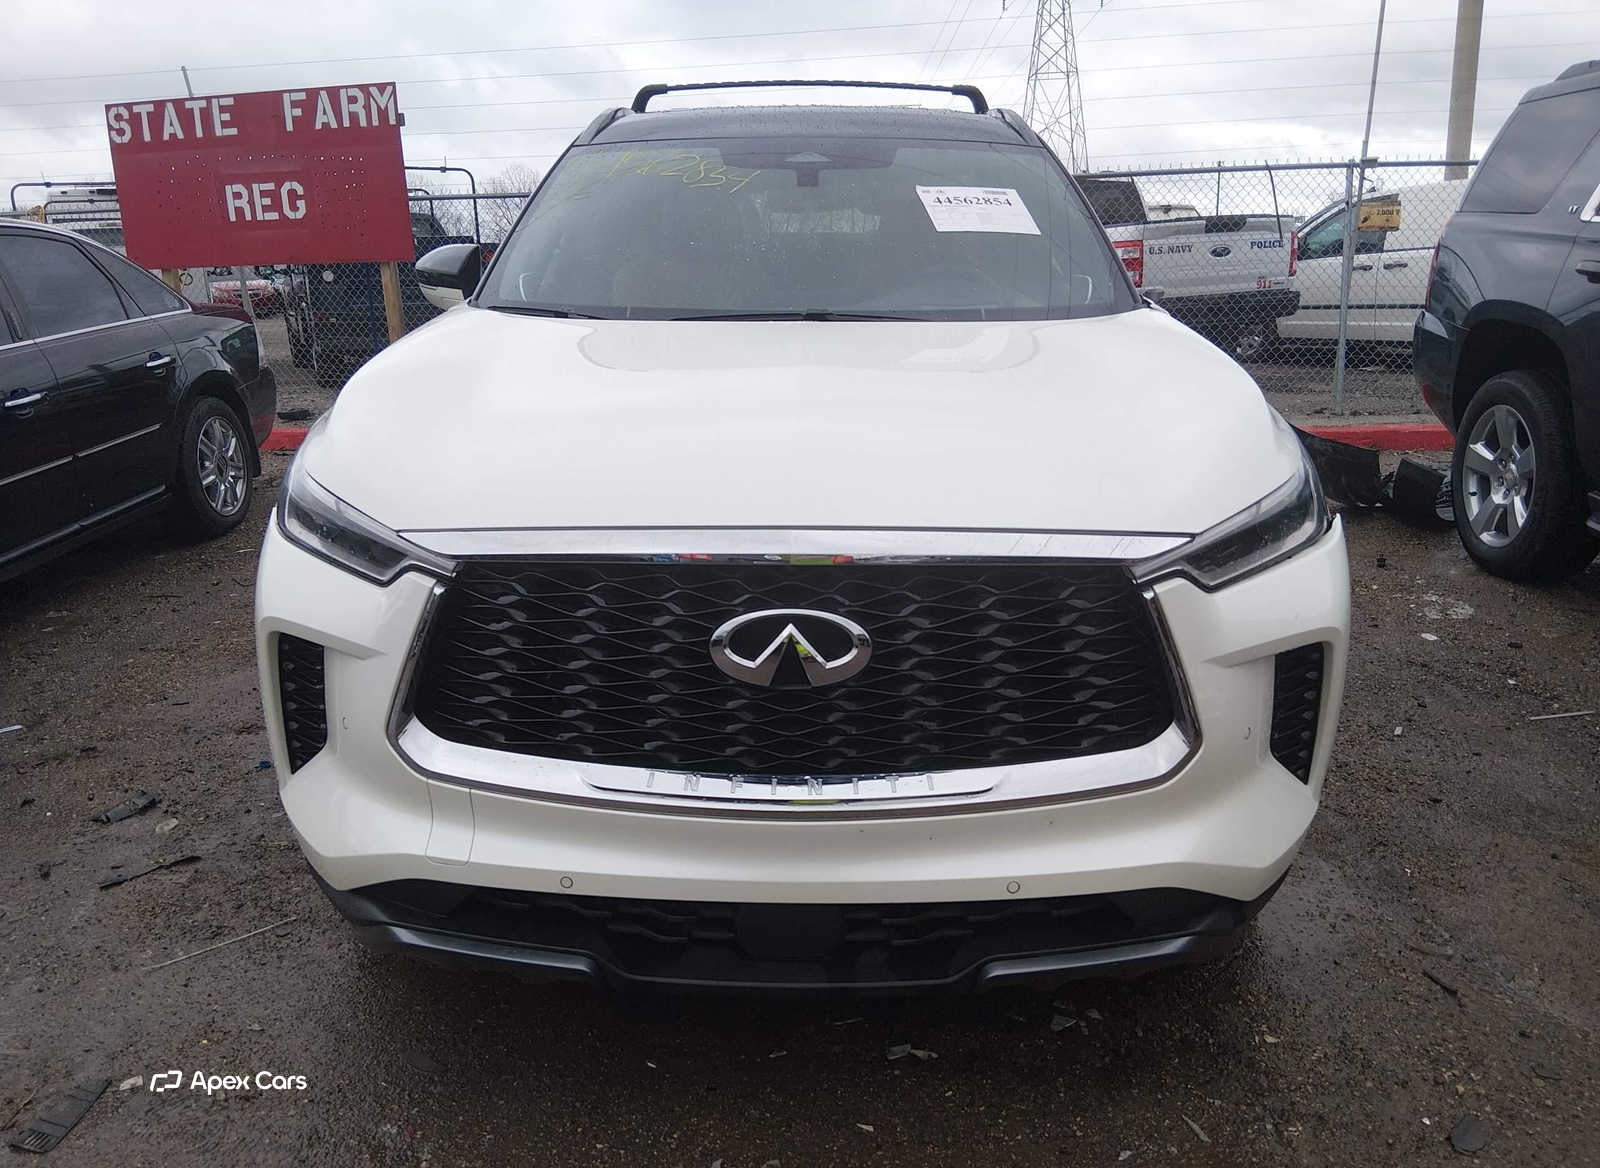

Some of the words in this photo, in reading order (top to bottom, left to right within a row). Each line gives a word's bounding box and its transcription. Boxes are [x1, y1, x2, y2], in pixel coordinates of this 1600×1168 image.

[107, 96, 238, 144] STATE
[282, 85, 397, 132] FARM
[224, 181, 307, 222] REG
[933, 195, 1013, 207] 44562854
[1148, 245, 1166, 255] U.S.
[1167, 244, 1194, 254] NAVY
[1250, 240, 1284, 249] POLICE
[1256, 280, 1272, 289] 911
[646, 769, 935, 795] INFINITI
